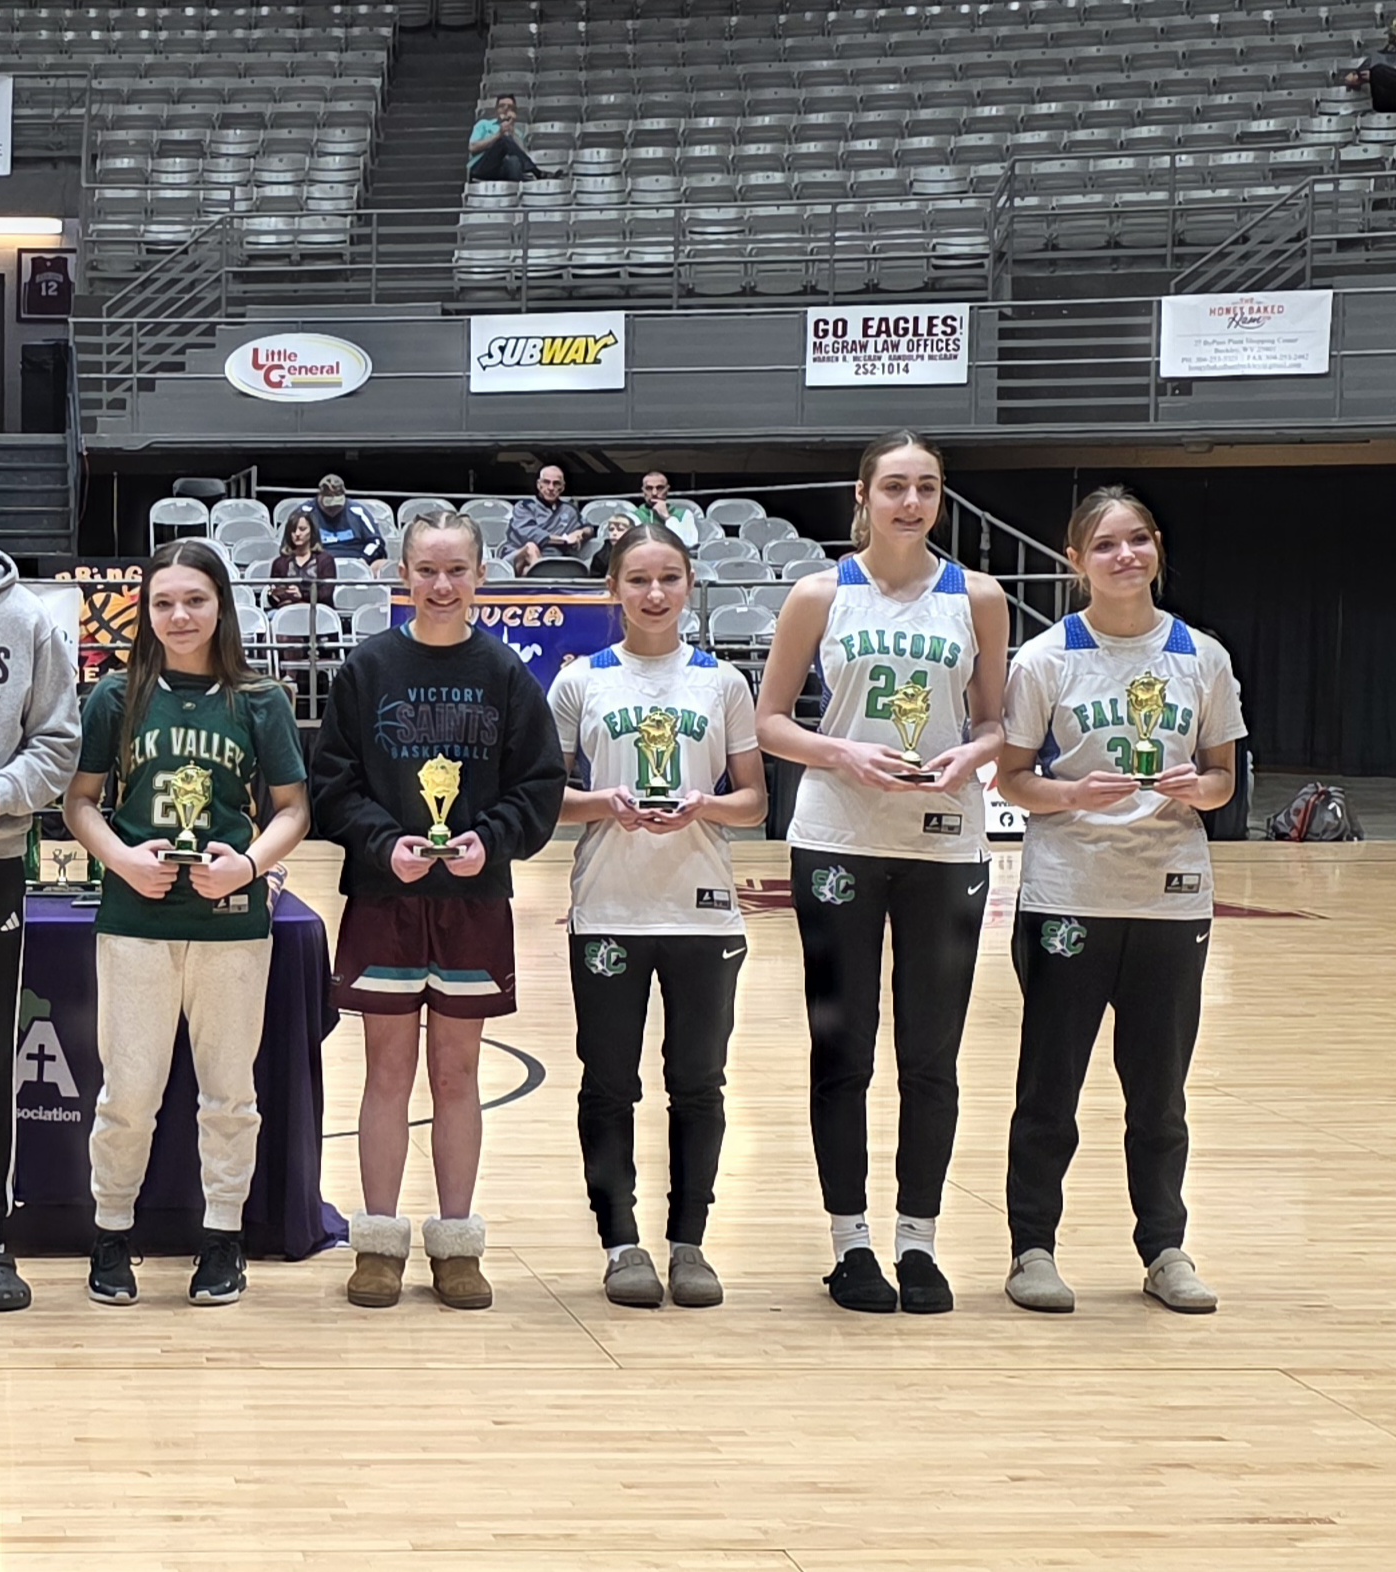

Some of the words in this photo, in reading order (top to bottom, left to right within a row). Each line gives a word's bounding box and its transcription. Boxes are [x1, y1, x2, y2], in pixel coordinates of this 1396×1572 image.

[41, 281, 58, 296] 12
[1209, 306, 1244, 317] HONEY
[1248, 304, 1285, 314] BAKED
[813, 317, 848, 339] GO
[862, 315, 964, 338] EAGLES!
[477, 330, 618, 371] SUBWAY
[812, 340, 869, 355] McGRAW
[874, 339, 901, 354] LAW
[906, 338, 961, 353] OFFICES
[251, 347, 298, 371] Little
[854, 363, 910, 376] 252-1014
[263, 361, 340, 389] General
[840, 629, 962, 669] FALCONS
[408, 687, 484, 703] VICTORY
[395, 703, 499, 746] SAINTS
[170, 727, 245, 778] VALLEY
[391, 745, 489, 760] BASKETBALL
